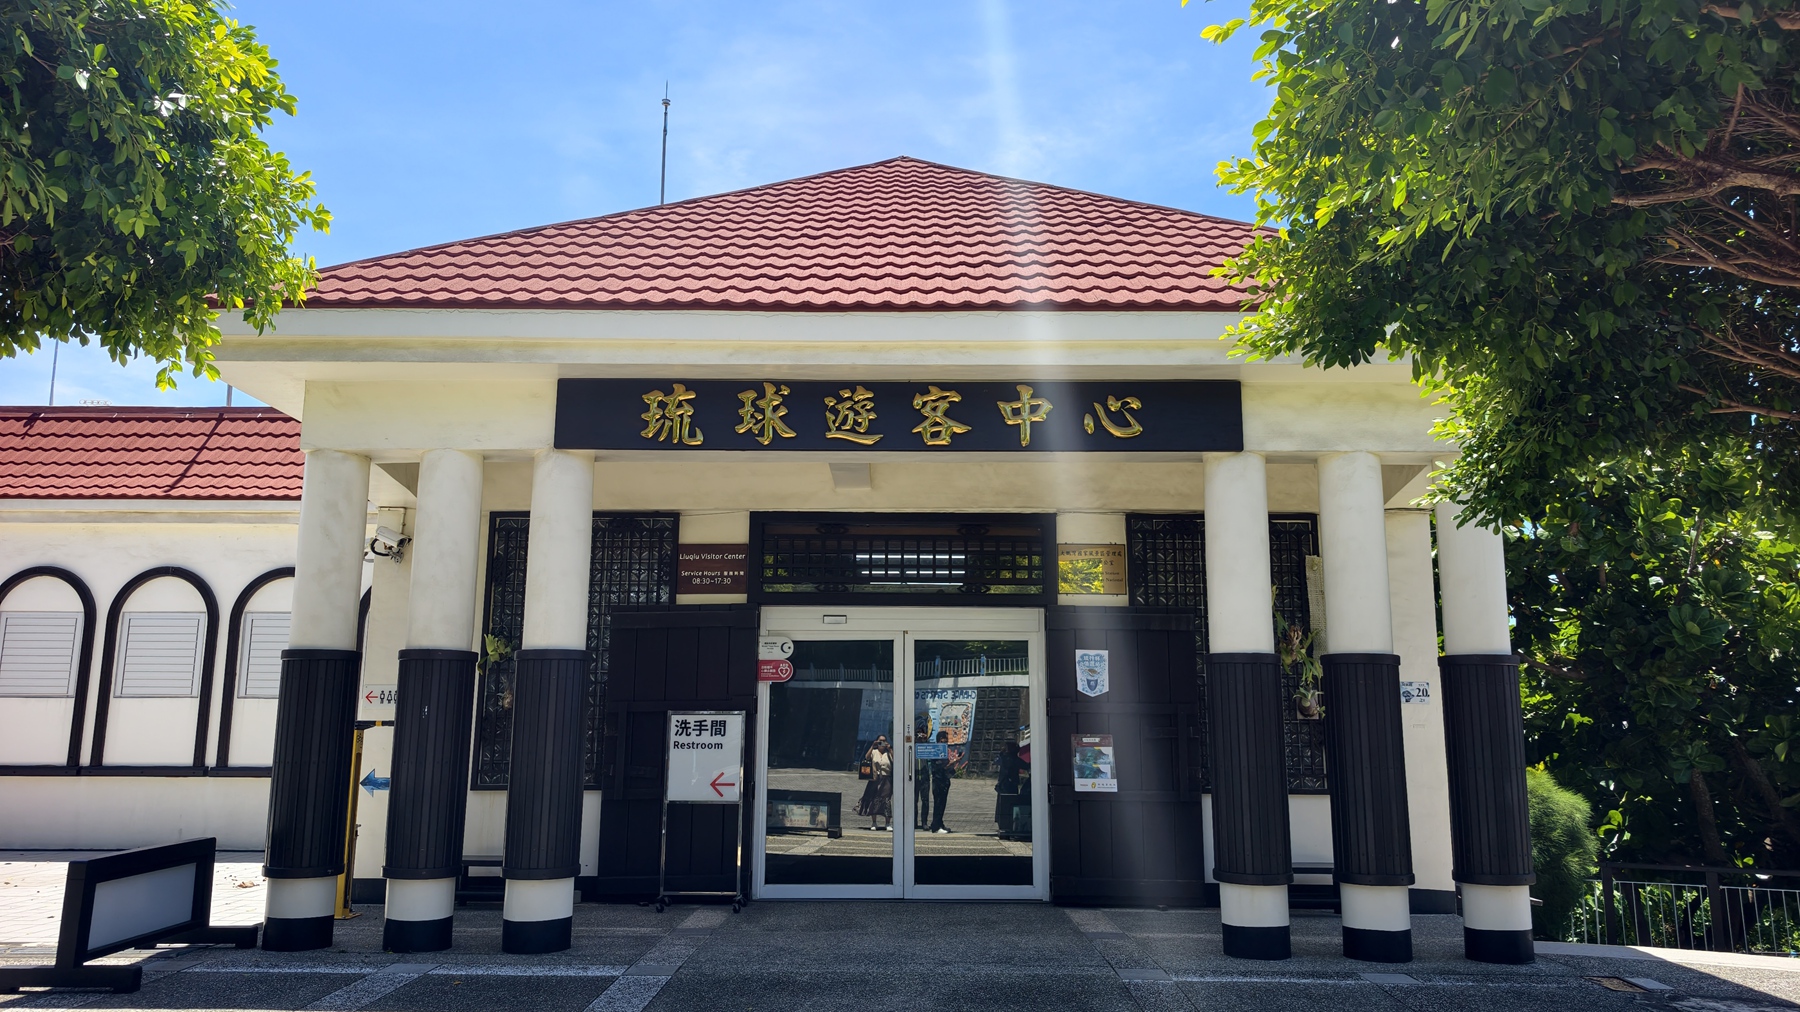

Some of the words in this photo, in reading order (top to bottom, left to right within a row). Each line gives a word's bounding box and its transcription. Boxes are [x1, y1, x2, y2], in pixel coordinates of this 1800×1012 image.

[640, 382, 1143, 447] 琉球遊客中心
[679, 553, 700, 561] Liuqiu
[674, 719, 727, 737] 洗手間
[673, 740, 724, 750] Restroom
